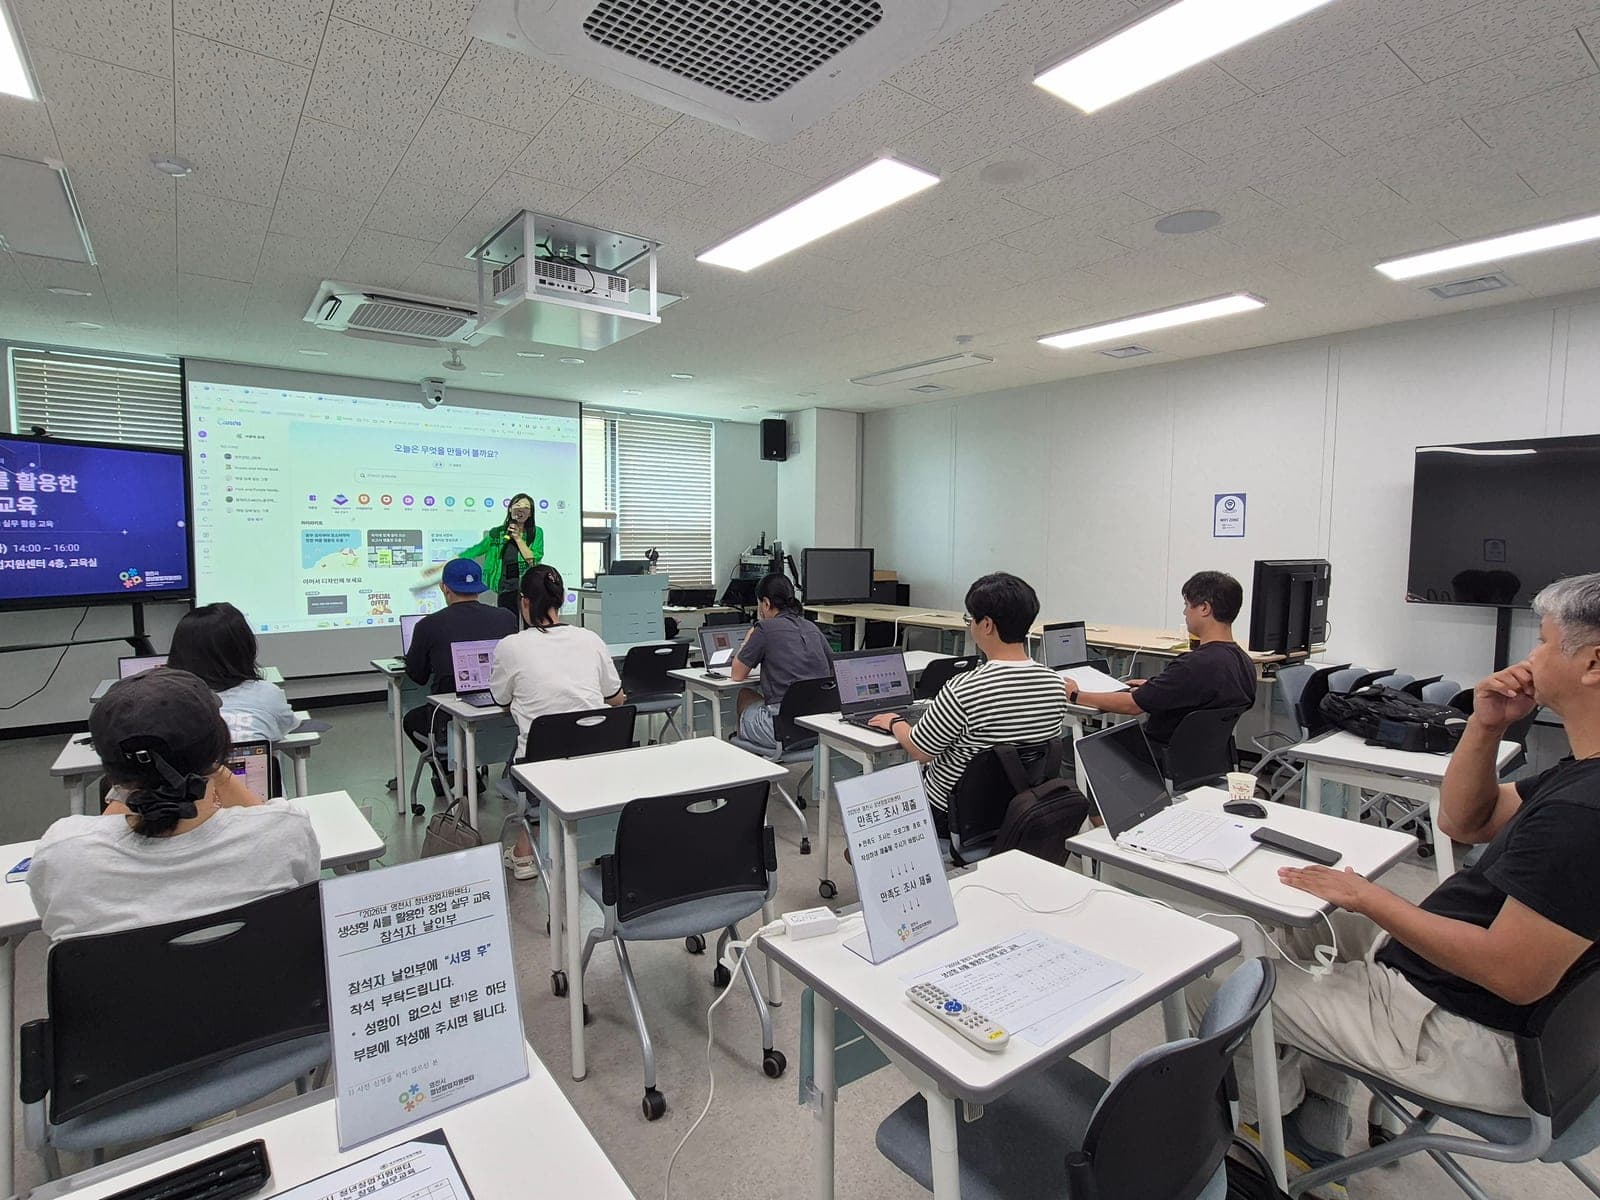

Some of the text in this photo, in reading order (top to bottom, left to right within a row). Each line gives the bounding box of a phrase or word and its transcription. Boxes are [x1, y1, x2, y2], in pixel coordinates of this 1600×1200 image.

[394, 444, 499, 458] 오늘은 무엇을 만들어 볼까요?
[15, 472, 78, 493] 활용한
[12, 544, 41, 552] 14:00
[53, 543, 80, 552] 16:00
[69, 557, 98, 568] 교육실
[856, 799, 917, 828] 만족도 조사 제출
[880, 886, 902, 903] 만족도
[903, 880, 917, 894] 조사
[337, 890, 491, 939] 생성형 AI를 활용한 창업 실무 교육
[379, 914, 457, 944] 참석자 날인부
[348, 974, 386, 995] 참석자
[391, 958, 438, 983] 날인부에
[381, 975, 455, 1007] 부탁드립니다.
[364, 1013, 400, 1036] 성함이
[407, 1001, 442, 1022] 없으신
[485, 980, 507, 996] 하단
[353, 1002, 507, 1063] 부분에 작성해 주시면 됩니다.
